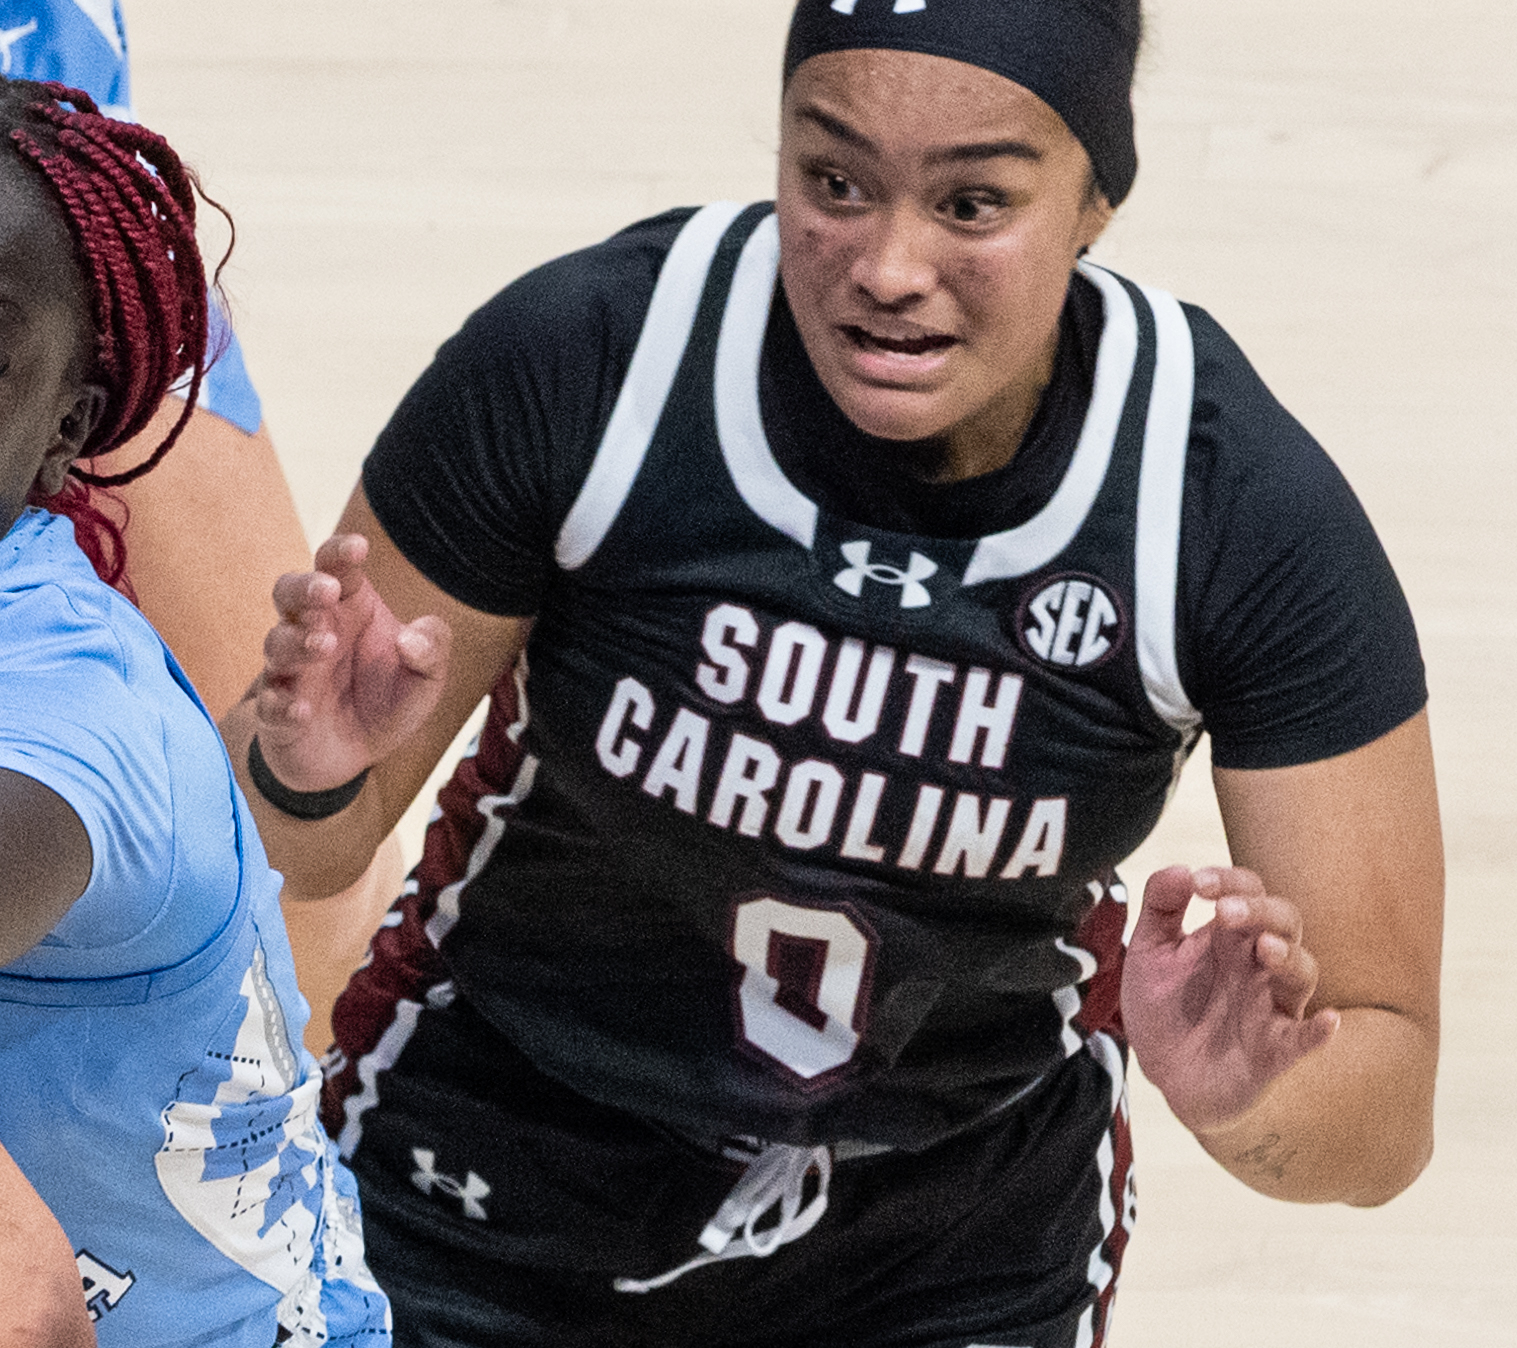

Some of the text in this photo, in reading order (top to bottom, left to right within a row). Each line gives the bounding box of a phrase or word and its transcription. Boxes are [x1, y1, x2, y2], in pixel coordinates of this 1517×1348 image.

[694, 602, 1024, 769] SOUTH
[1024, 579, 1118, 668] SEC
[594, 675, 1069, 880] CAROLINA
[730, 893, 874, 1084] 0
